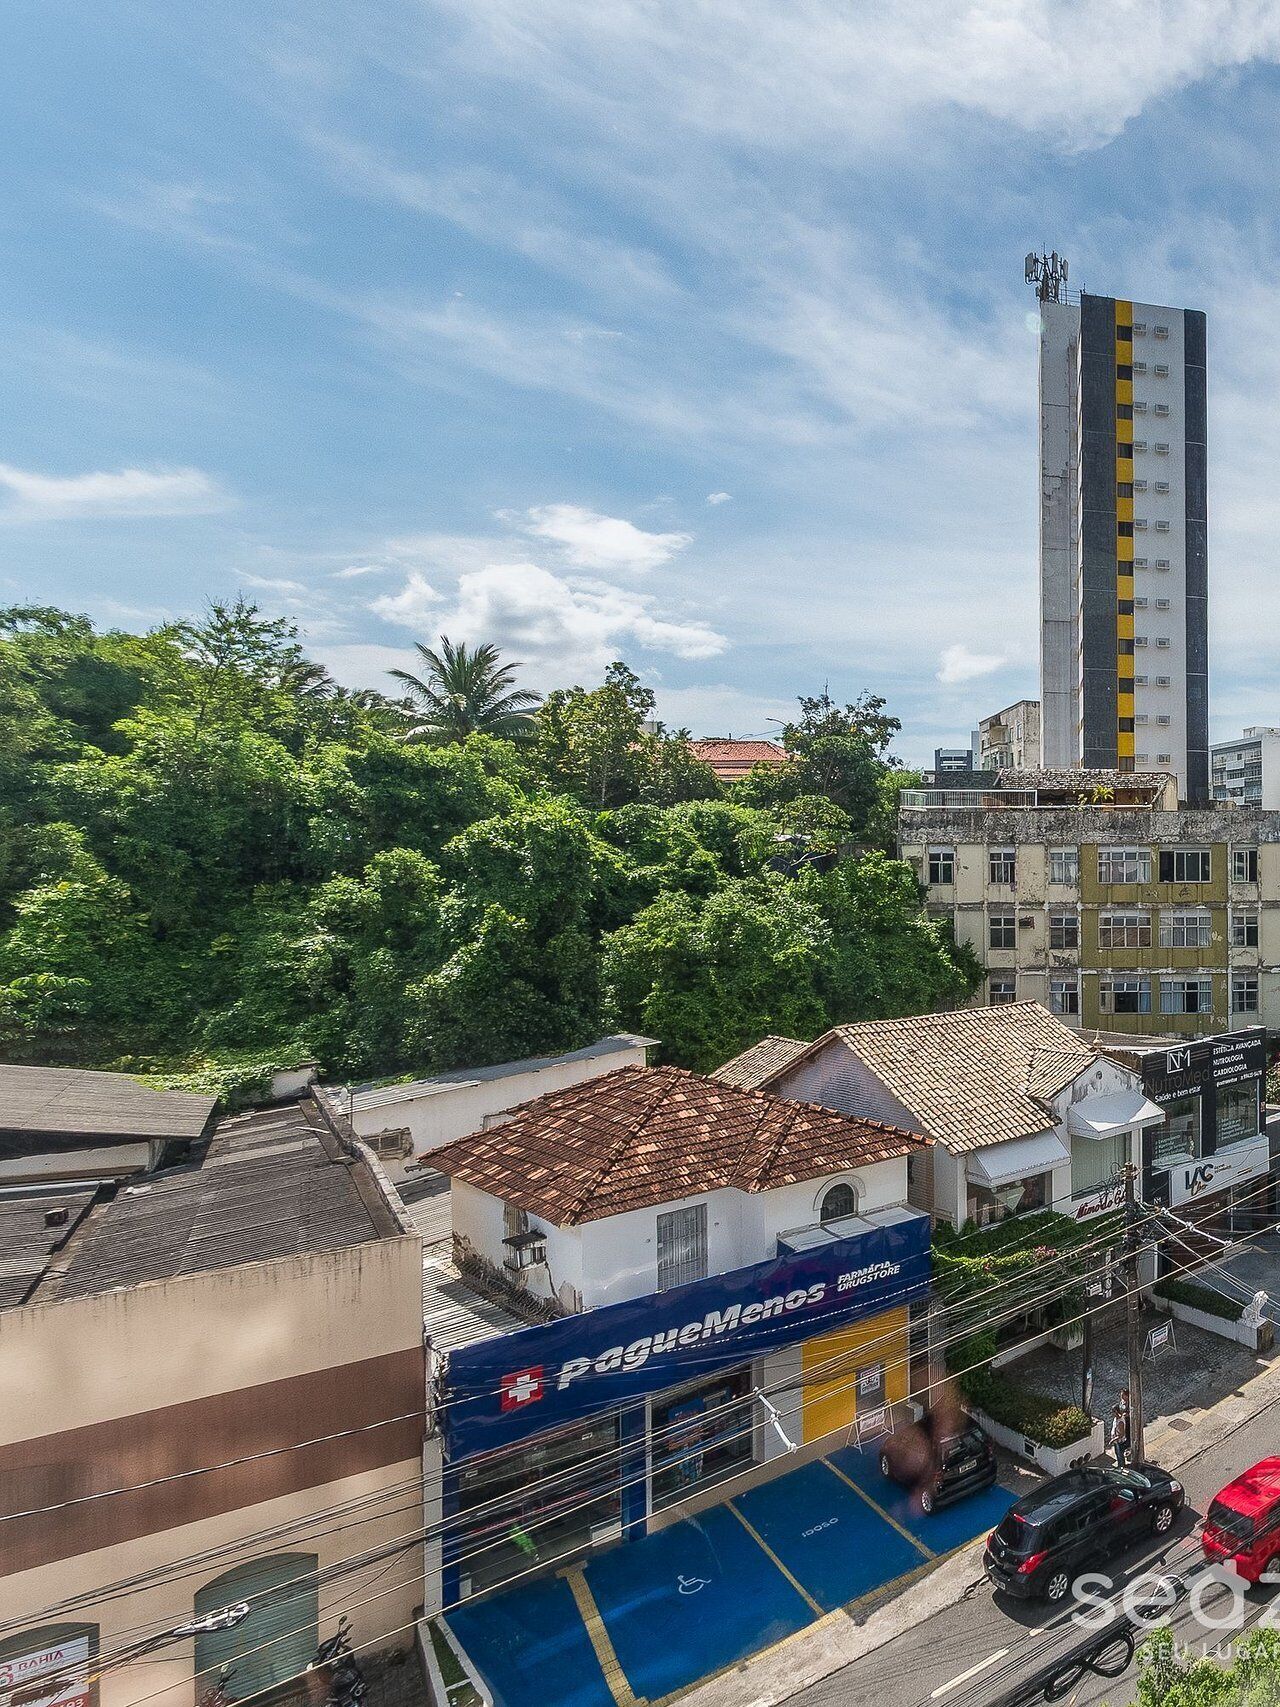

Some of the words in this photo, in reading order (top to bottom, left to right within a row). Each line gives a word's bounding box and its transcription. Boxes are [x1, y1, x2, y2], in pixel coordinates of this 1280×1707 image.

[1213, 1064, 1248, 1077] CARDIOLOGIA
[1155, 1091, 1172, 1102] Saúde
[1177, 1087, 1188, 1096] bem
[1189, 1085, 1202, 1094] estar
[837, 1265, 900, 1292] DRUGSTORE
[19, 1650, 64, 1670] BAHIA
